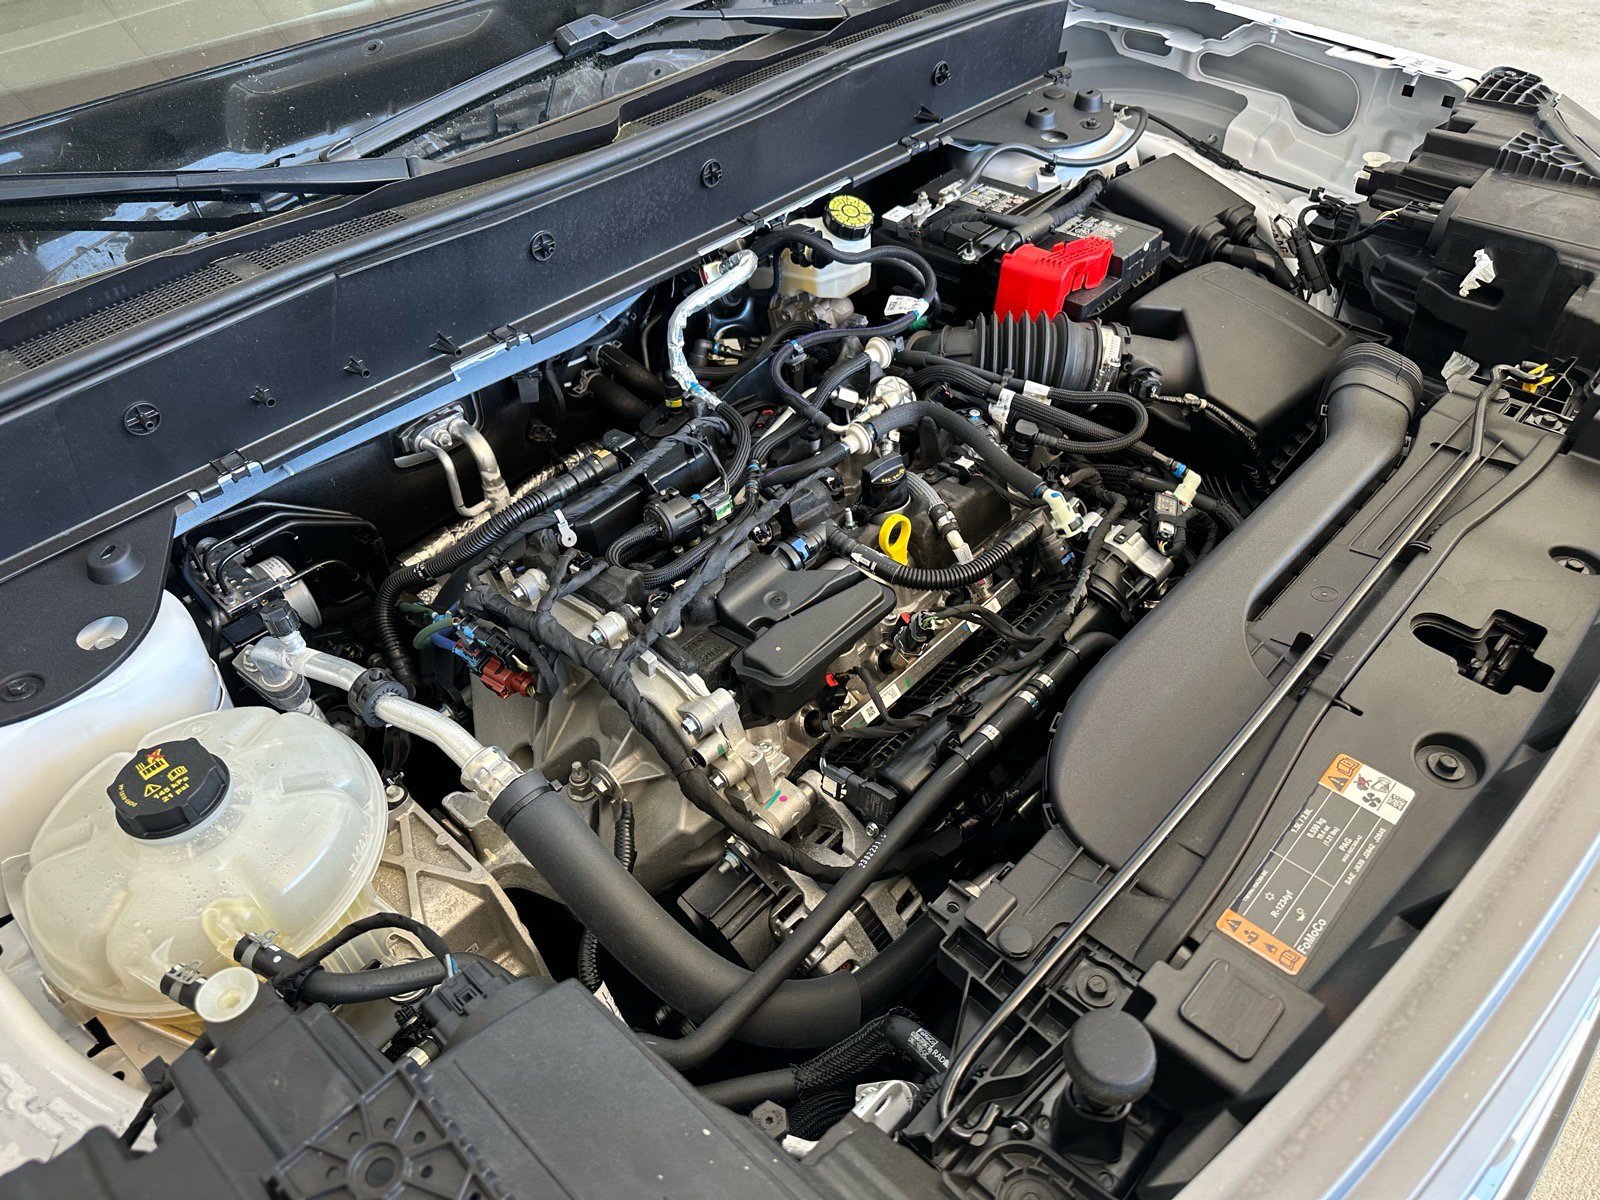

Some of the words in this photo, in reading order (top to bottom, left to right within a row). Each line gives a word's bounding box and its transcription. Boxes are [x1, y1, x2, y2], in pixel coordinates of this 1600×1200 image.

[153, 787, 171, 799] 145
[1338, 837, 1352, 852] PAG
[1344, 872, 1357, 886] SAE
[1270, 889, 1293, 918] R-1234yf
[1296, 918, 1327, 955] FoMoCo
